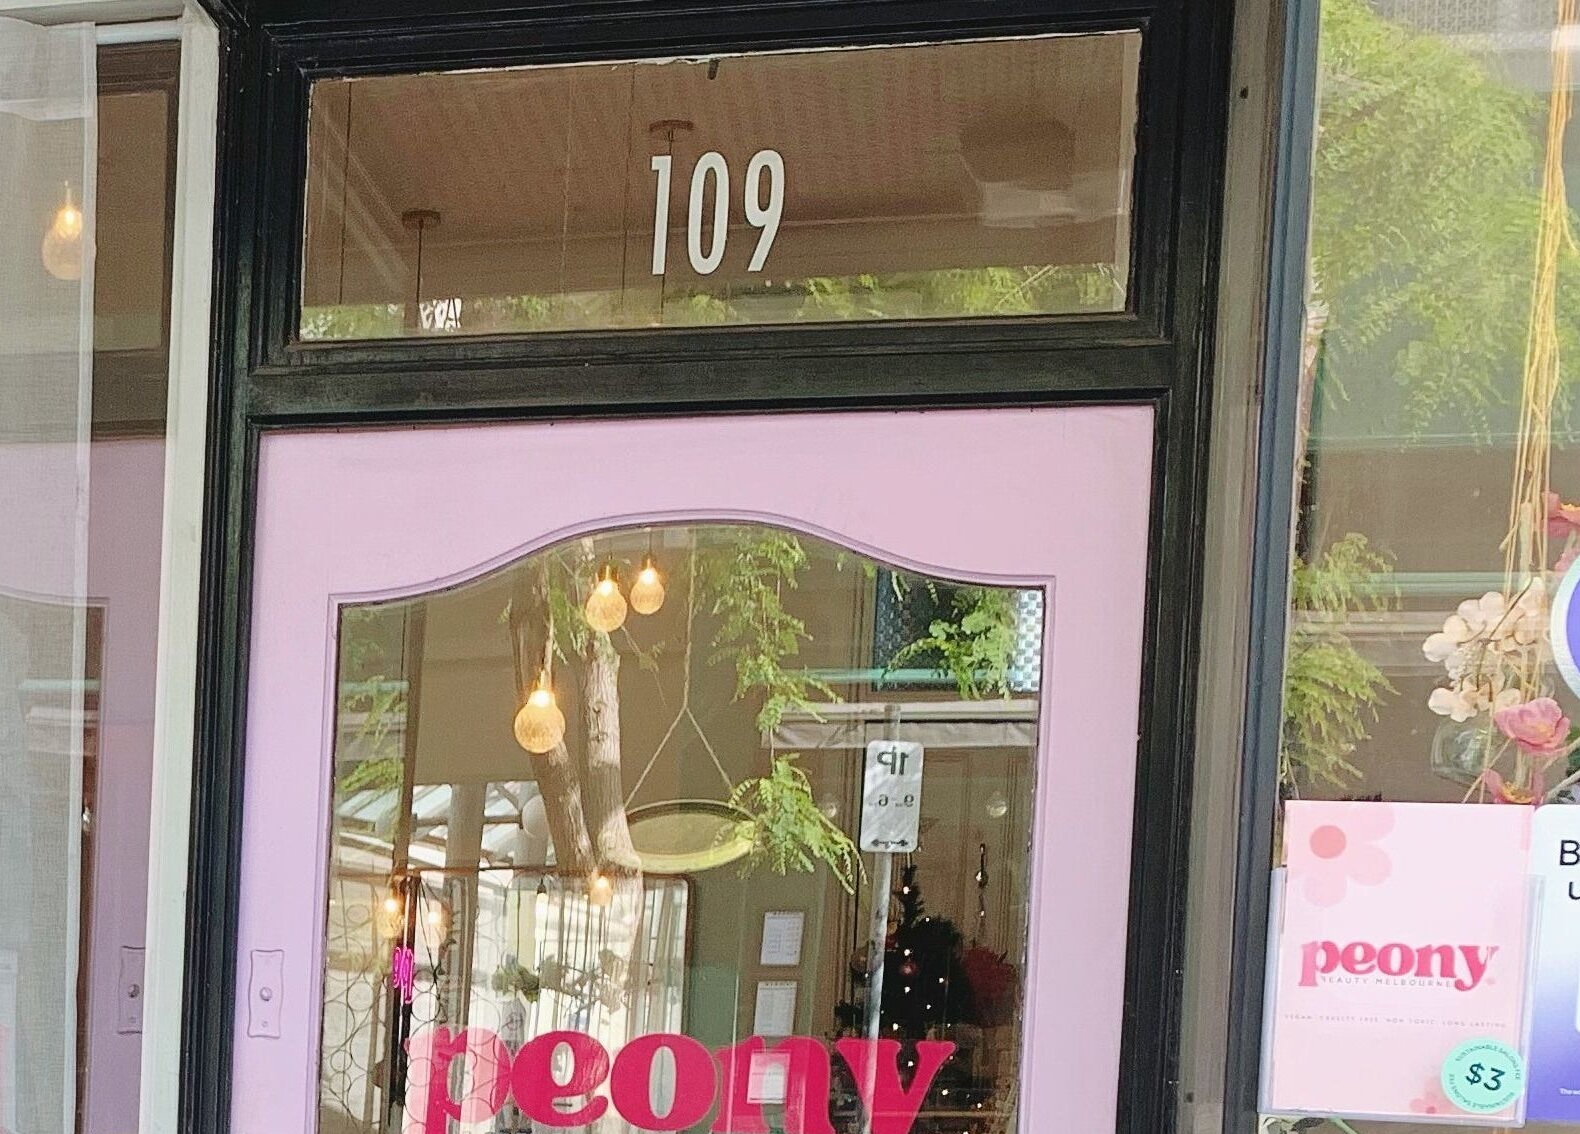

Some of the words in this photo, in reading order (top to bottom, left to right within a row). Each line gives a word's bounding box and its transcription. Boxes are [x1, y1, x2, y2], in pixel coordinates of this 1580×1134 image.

[651, 149, 785, 275] 109
[1298, 940, 1500, 992] peony
[1375, 977, 1451, 988] MELBOURNE
[1466, 1062, 1506, 1091] $3
